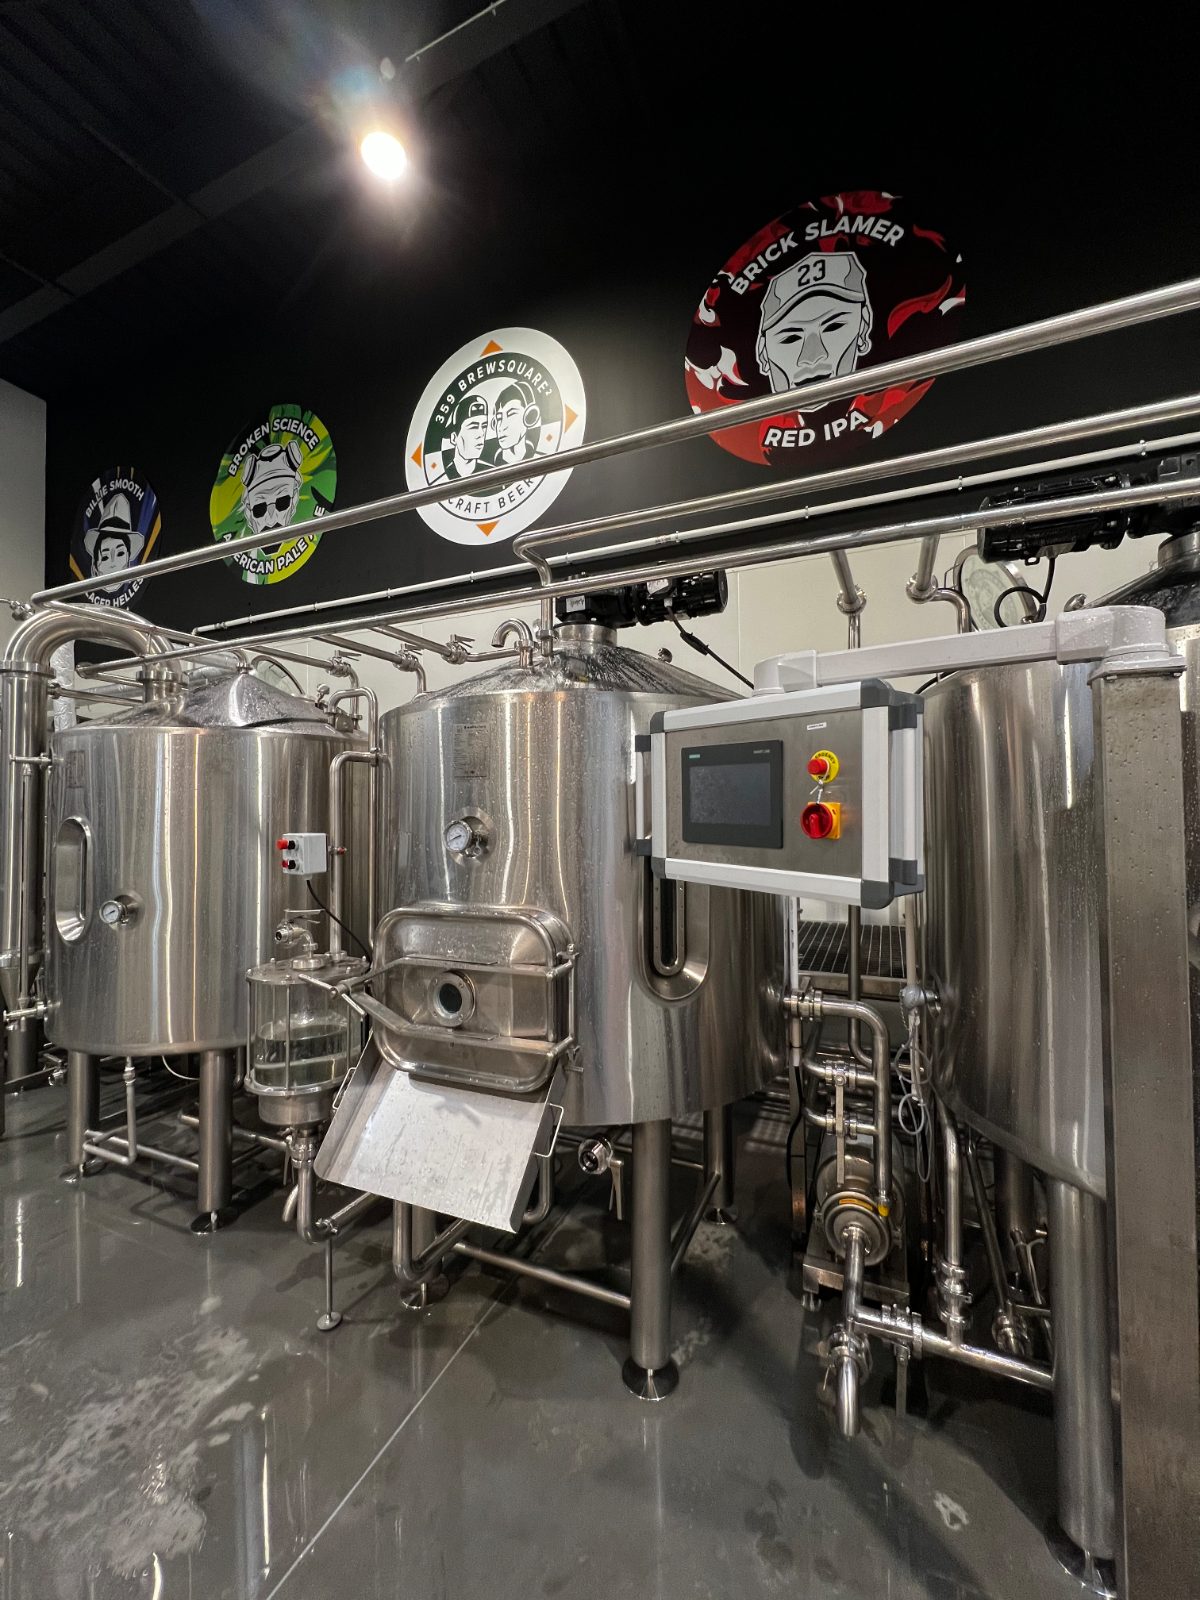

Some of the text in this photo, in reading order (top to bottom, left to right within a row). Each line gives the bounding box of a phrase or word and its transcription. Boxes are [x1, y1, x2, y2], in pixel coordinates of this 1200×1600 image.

[731, 215, 905, 295] BRICK SLAMER
[797, 259, 826, 287] 23
[435, 394, 455, 424] 359
[764, 410, 869, 448] RED IPA
[228, 418, 320, 477] BROKEN SCIENCE
[109, 478, 145, 501] SMOOTH
[498, 478, 534, 508] BEER
[223, 533, 308, 573] AERICAN PALE
